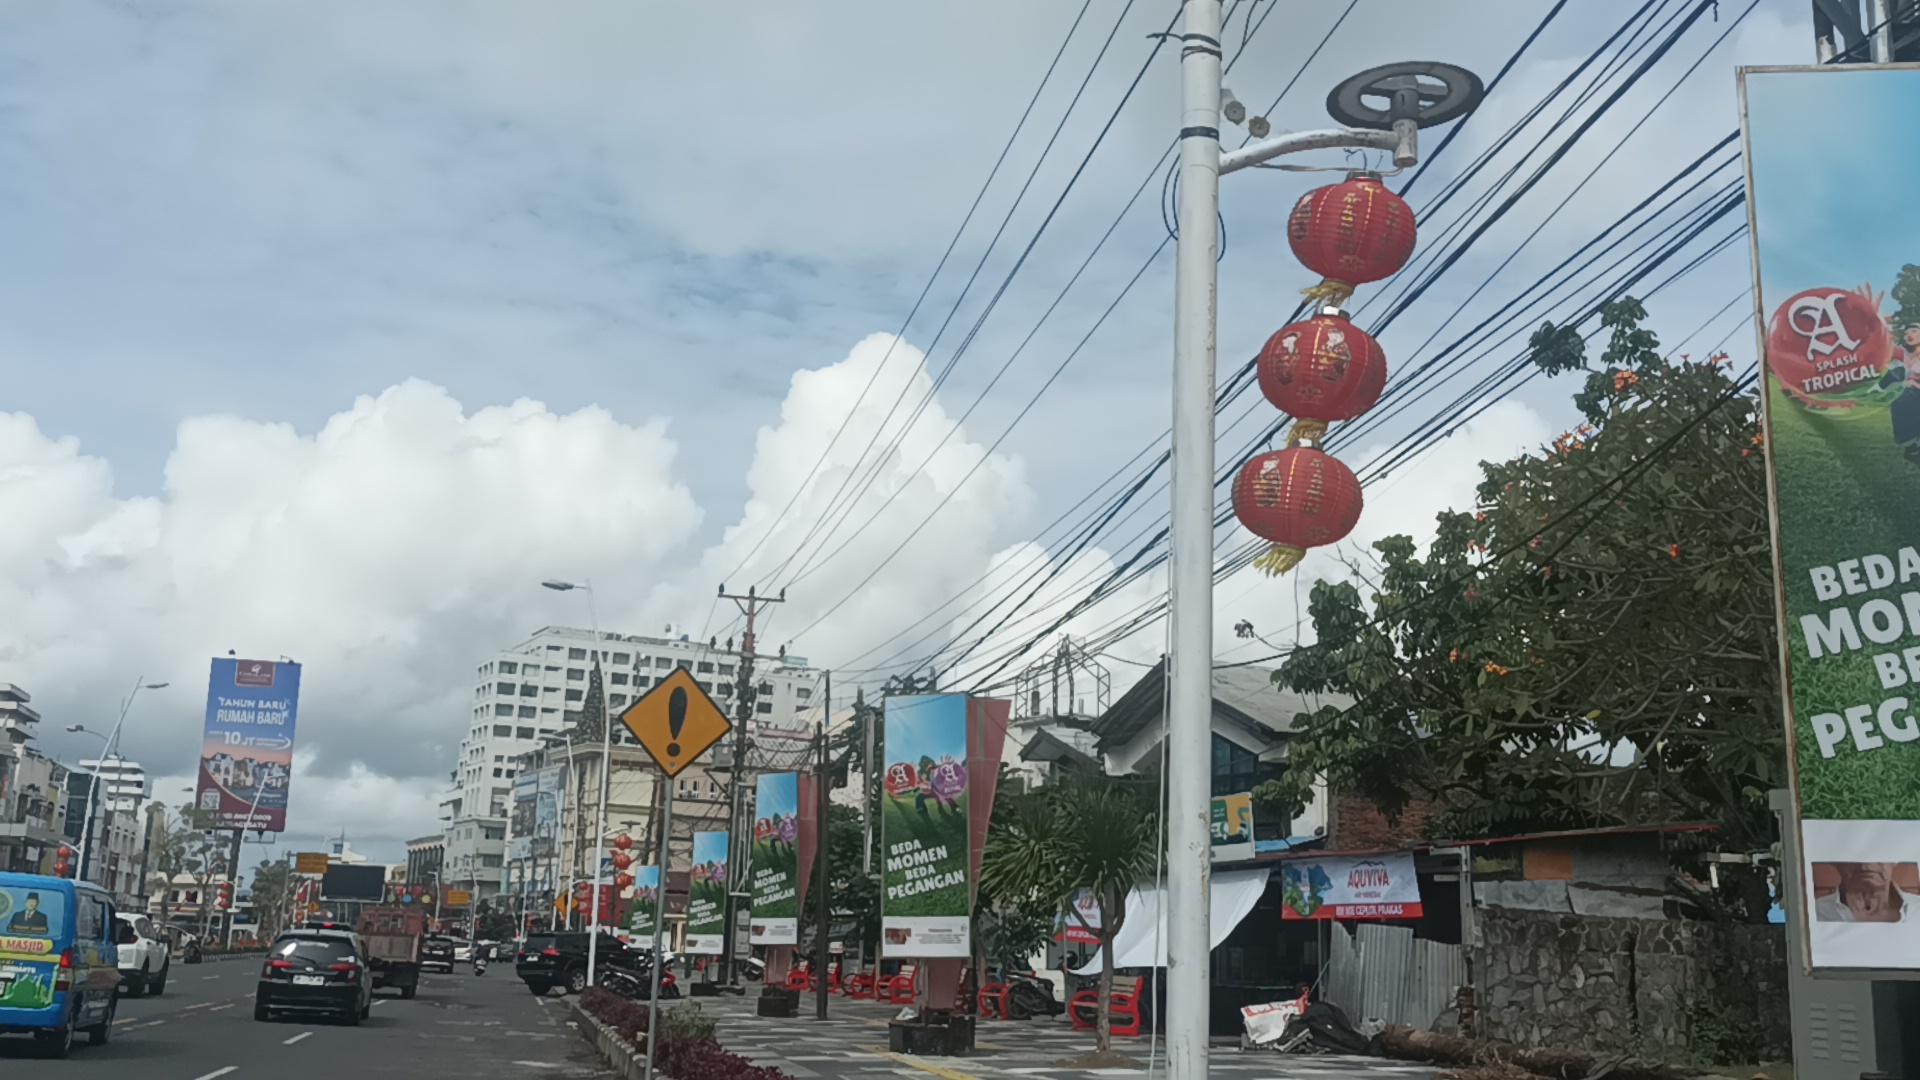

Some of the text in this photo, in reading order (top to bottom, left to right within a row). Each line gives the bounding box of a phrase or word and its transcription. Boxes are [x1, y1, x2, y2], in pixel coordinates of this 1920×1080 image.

[1816, 353, 1858, 372] SPLASH
[1802, 364, 1880, 393] TROPICAL
[1809, 546, 1920, 602] BEDA
[218, 697, 287, 710] TAHUN BARU
[216, 709, 286, 725] RUMAH BARU
[1810, 697, 1920, 759] PEG
[224, 731, 241, 745] 10
[890, 839, 922, 856] BEDA
[887, 845, 948, 872] MOMEN
[754, 871, 787, 889] MOMEN
[756, 867, 773, 879] BEDA
[905, 864, 936, 881] BEDA
[887, 869, 965, 900] PEGANGAN
[753, 888, 796, 908] PEGANGAN
[6, 941, 44, 953] MASJID
